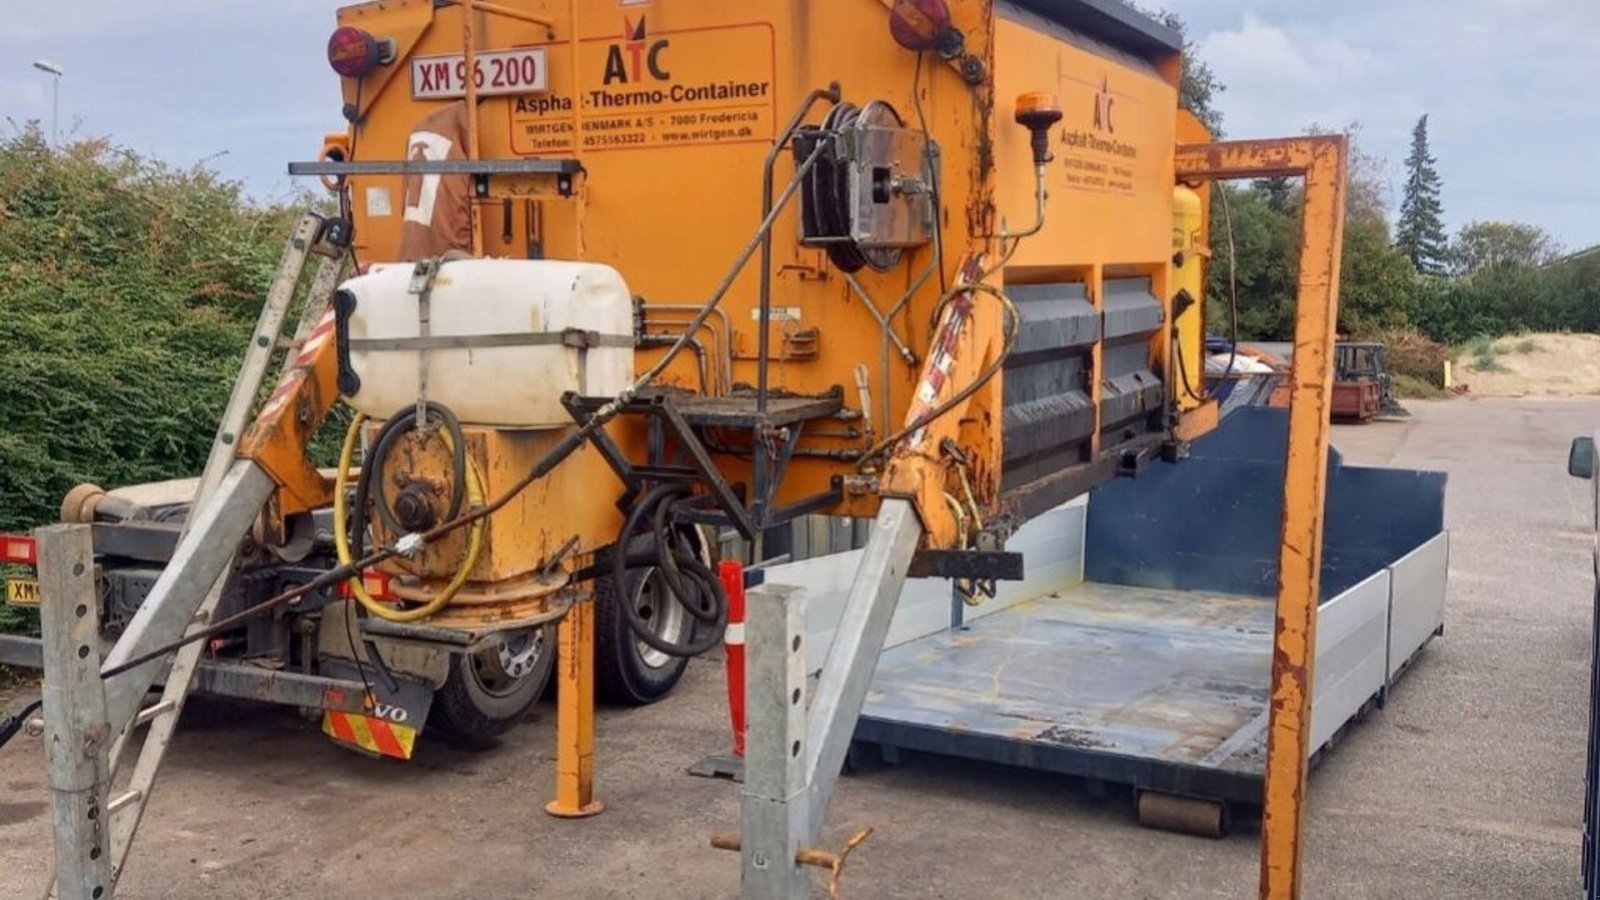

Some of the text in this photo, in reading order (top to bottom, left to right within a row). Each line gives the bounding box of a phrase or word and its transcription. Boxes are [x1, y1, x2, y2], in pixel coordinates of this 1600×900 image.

[419, 62, 450, 92] XM
[491, 55, 536, 88] 200
[603, 39, 670, 85] ATC
[515, 81, 769, 116] Aspha-Thermo-Container
